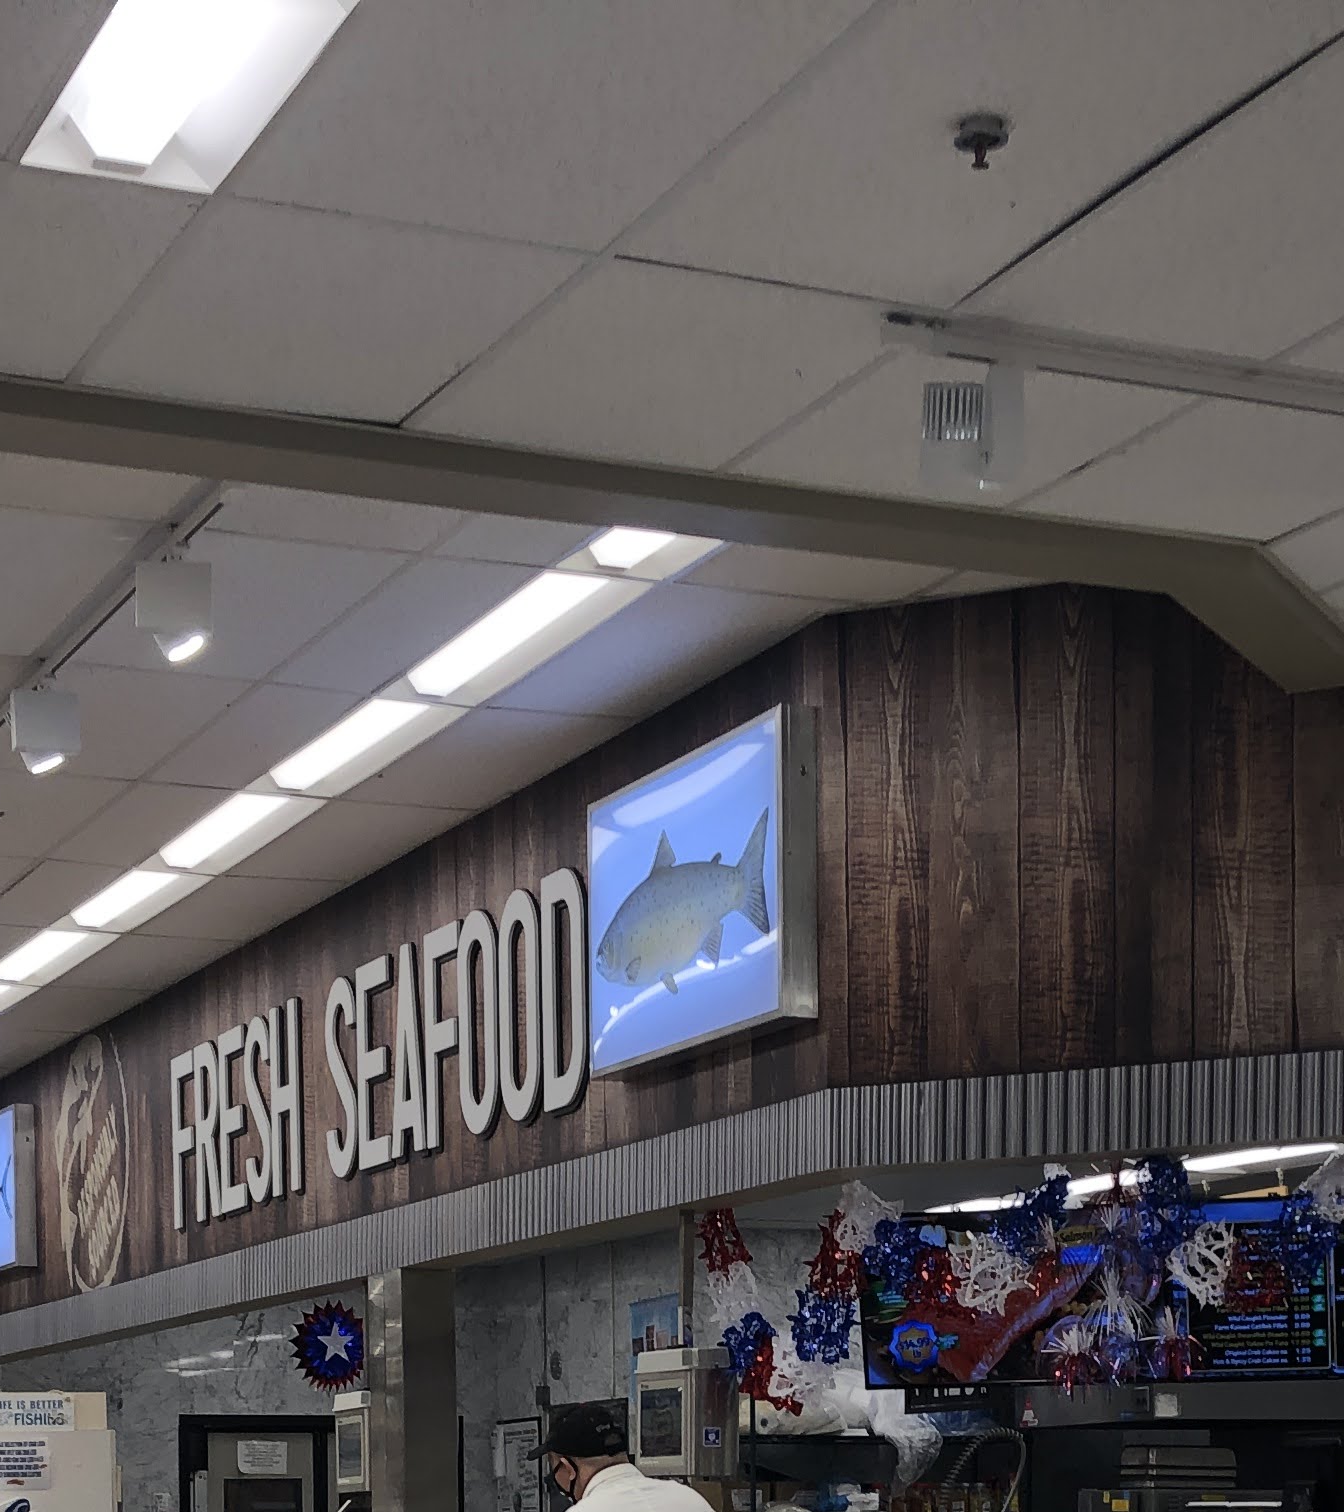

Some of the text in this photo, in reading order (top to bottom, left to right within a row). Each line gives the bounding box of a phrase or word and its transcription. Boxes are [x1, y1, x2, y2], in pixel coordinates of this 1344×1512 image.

[170, 867, 589, 1231] FRESH SEAFOOD
[17, 1400, 26, 1410] IS
[30, 1399, 64, 1410] BETTER
